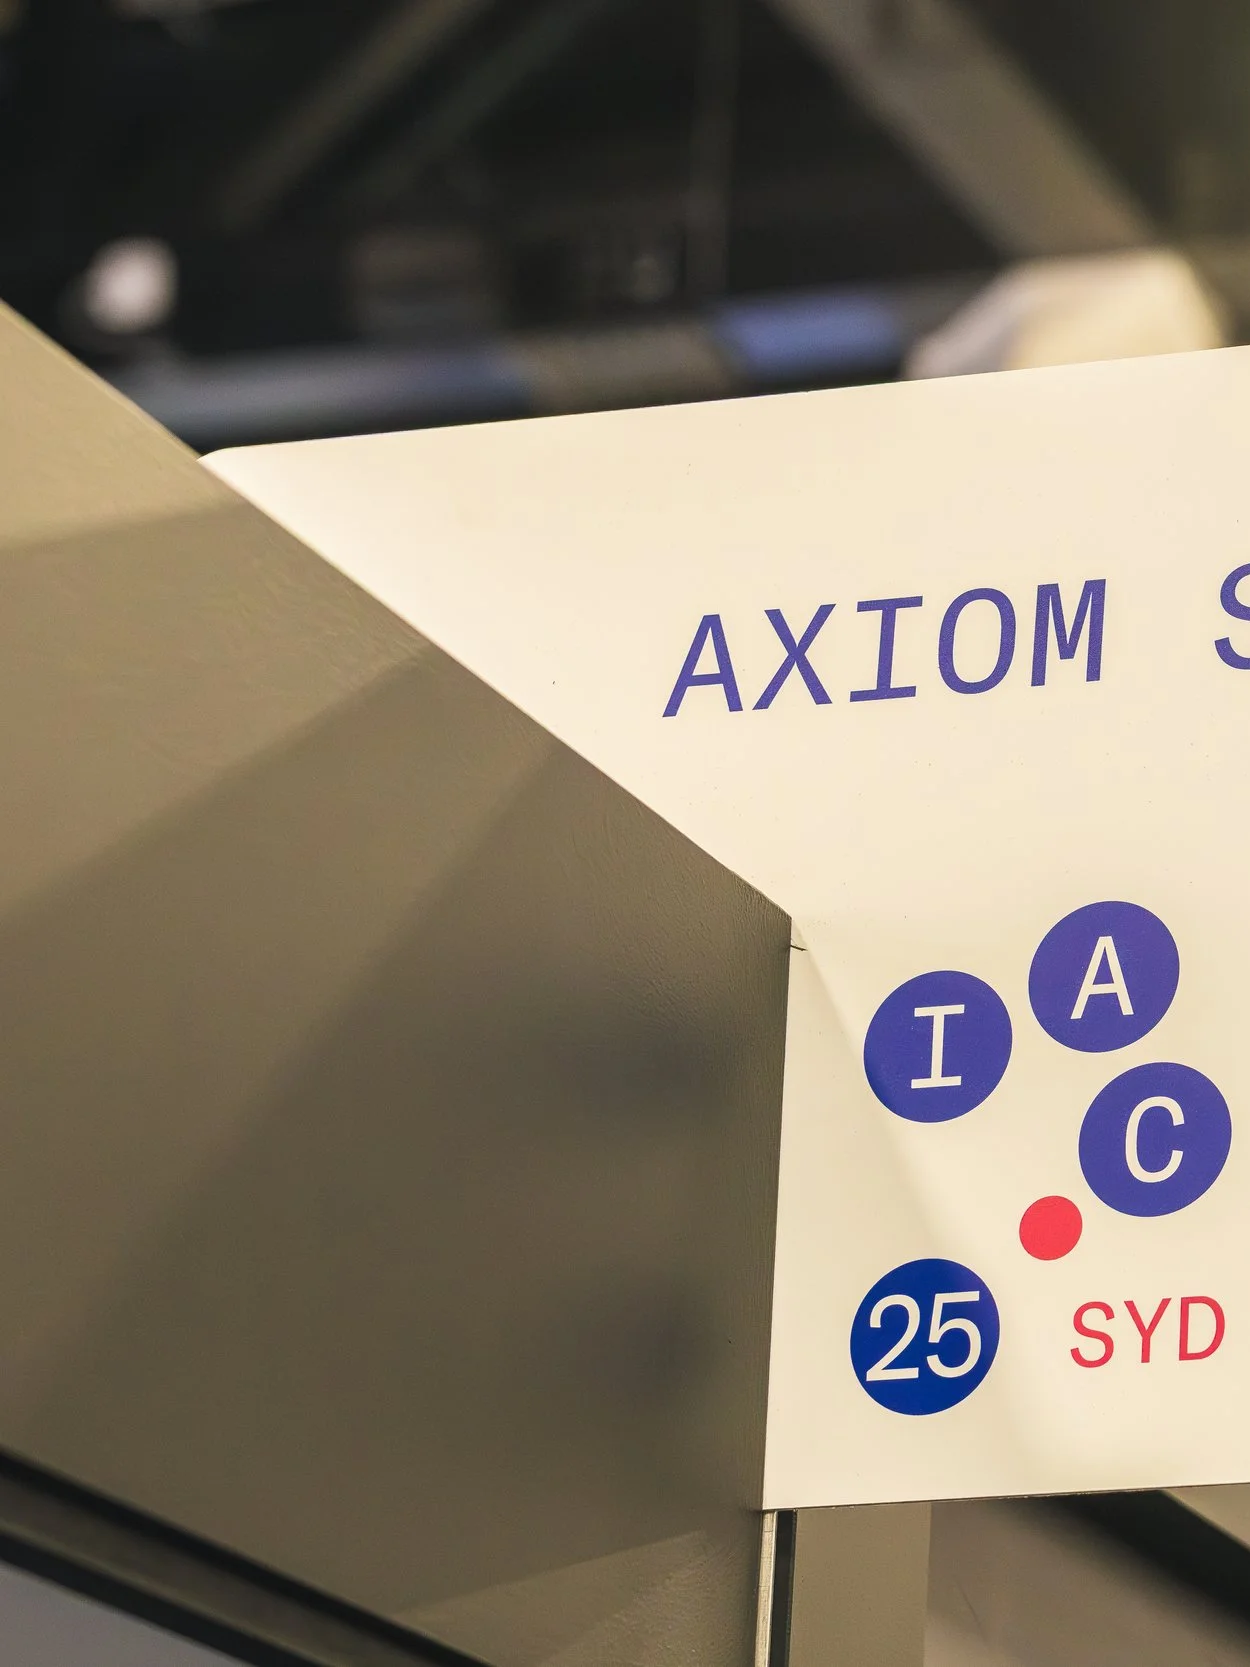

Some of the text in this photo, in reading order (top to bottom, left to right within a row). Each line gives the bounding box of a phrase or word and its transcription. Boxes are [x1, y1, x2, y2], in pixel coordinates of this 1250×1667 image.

[663, 579, 1107, 717] AXIOM
[866, 1291, 981, 1381] 25
[1070, 1295, 1226, 1369] SYD
